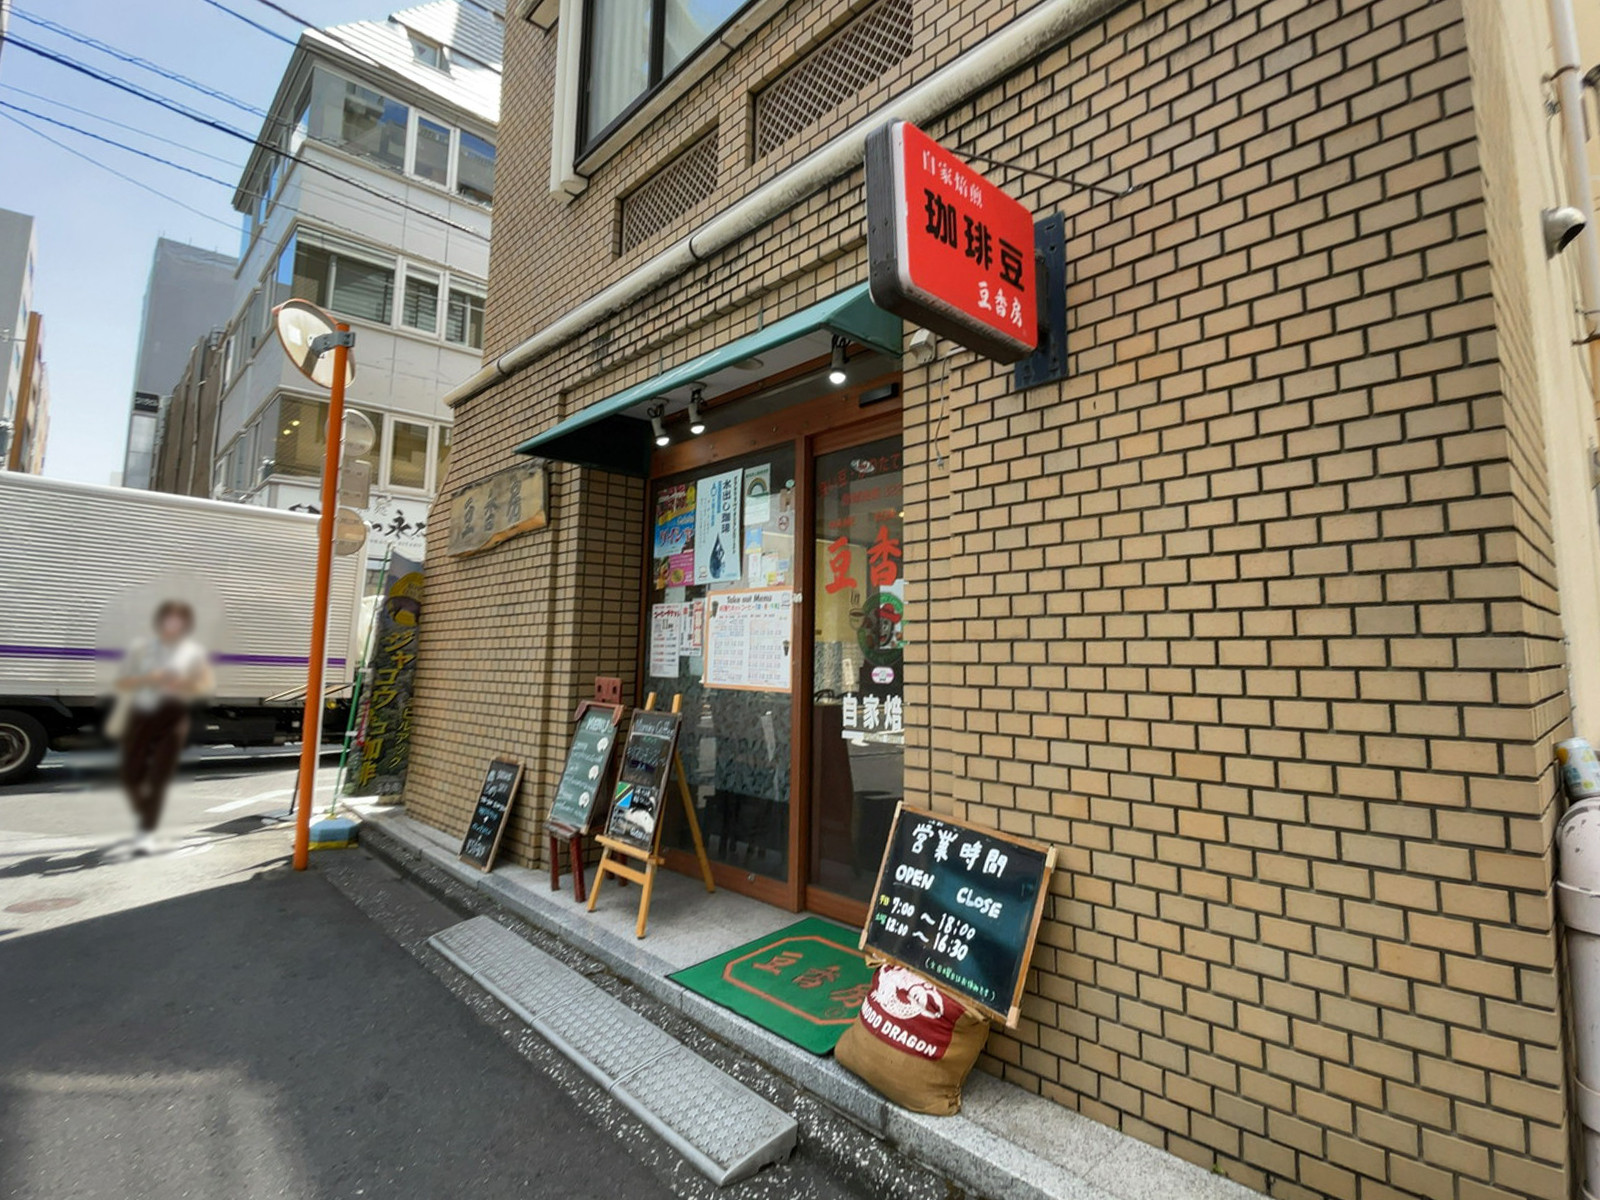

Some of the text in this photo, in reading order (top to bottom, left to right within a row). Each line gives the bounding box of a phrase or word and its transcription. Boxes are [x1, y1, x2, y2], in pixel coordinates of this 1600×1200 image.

[924, 188, 1025, 292] 珈琲豆
[977, 281, 1023, 328] 豆香房
[825, 525, 902, 595] 豆香
[842, 693, 902, 731] 自家焙
[912, 822, 1008, 878] 営業時間
[895, 864, 935, 890] OPEN
[892, 897, 915, 917] 7:00
[938, 913, 976, 941] 18:00
[956, 887, 1003, 919] CLOSE
[885, 915, 909, 937] 12:00
[932, 932, 969, 961] 16:30
[880, 1019, 938, 1057] DRAGON
